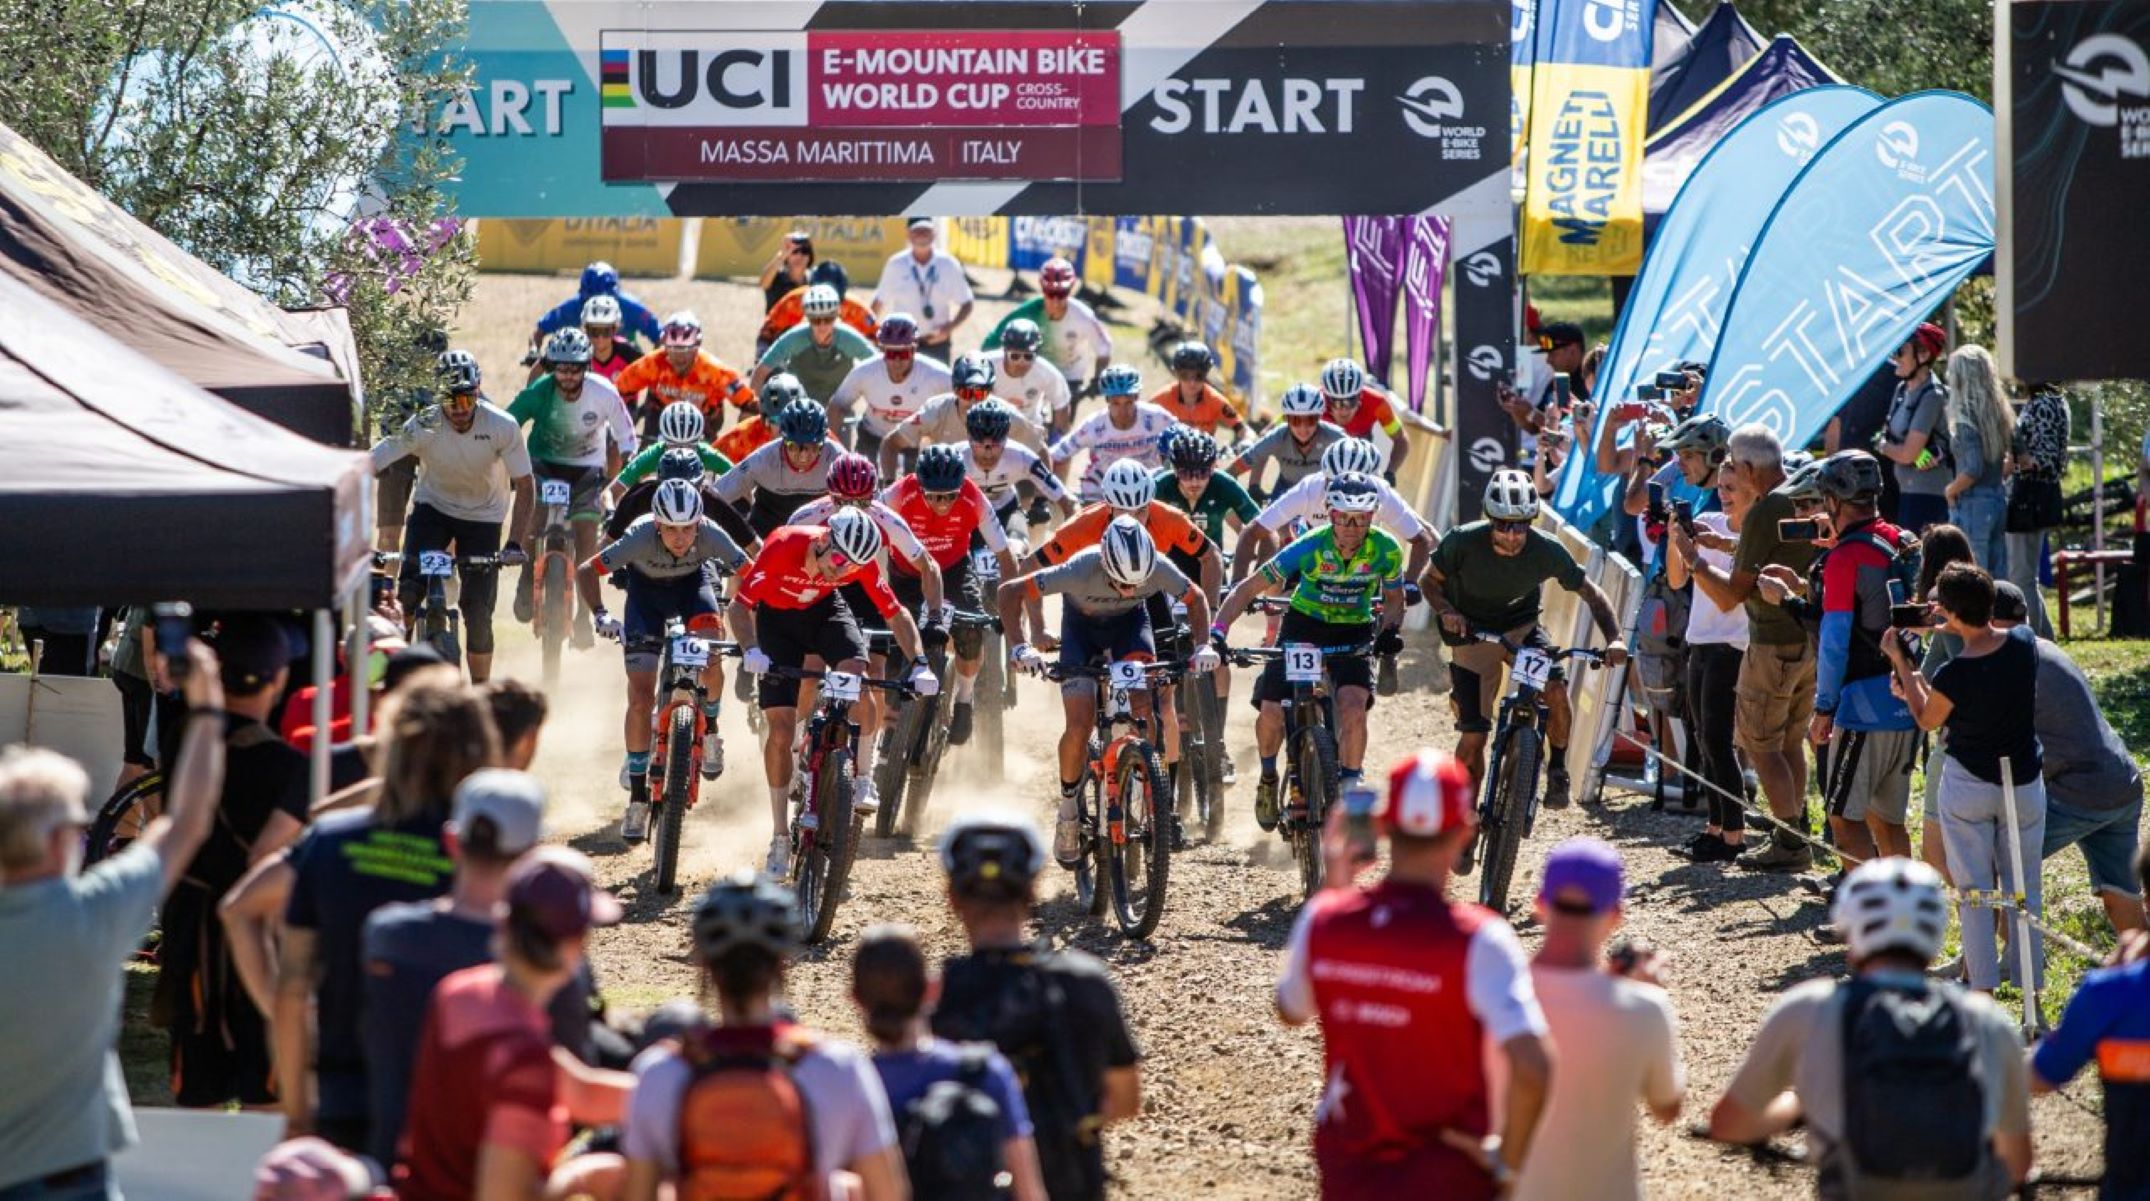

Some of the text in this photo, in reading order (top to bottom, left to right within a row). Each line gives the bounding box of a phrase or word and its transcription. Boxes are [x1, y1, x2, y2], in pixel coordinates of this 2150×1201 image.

[823, 48, 1106, 74] E-MOUNTAIN BIKE
[638, 48, 790, 109] UCI
[822, 83, 1010, 110] WORLD CUP
[1016, 97, 1081, 110] COUNTRY
[1150, 78, 1365, 135] START
[1441, 126, 1486, 138] WORLD
[700, 140, 935, 164] MASSA MARITTIMA
[962, 140, 1023, 164] ITALY
[1441, 138, 1479, 149] E-BIKE
[1441, 149, 1481, 160] SERIES
[1546, 90, 1589, 246] MAGNETI
[1582, 90, 1621, 246] MARELLI
[1122, 664, 1134, 678] 6
[1293, 652, 1314, 670] 13
[1525, 655, 1546, 675] 17
[837, 675, 850, 687] 7
